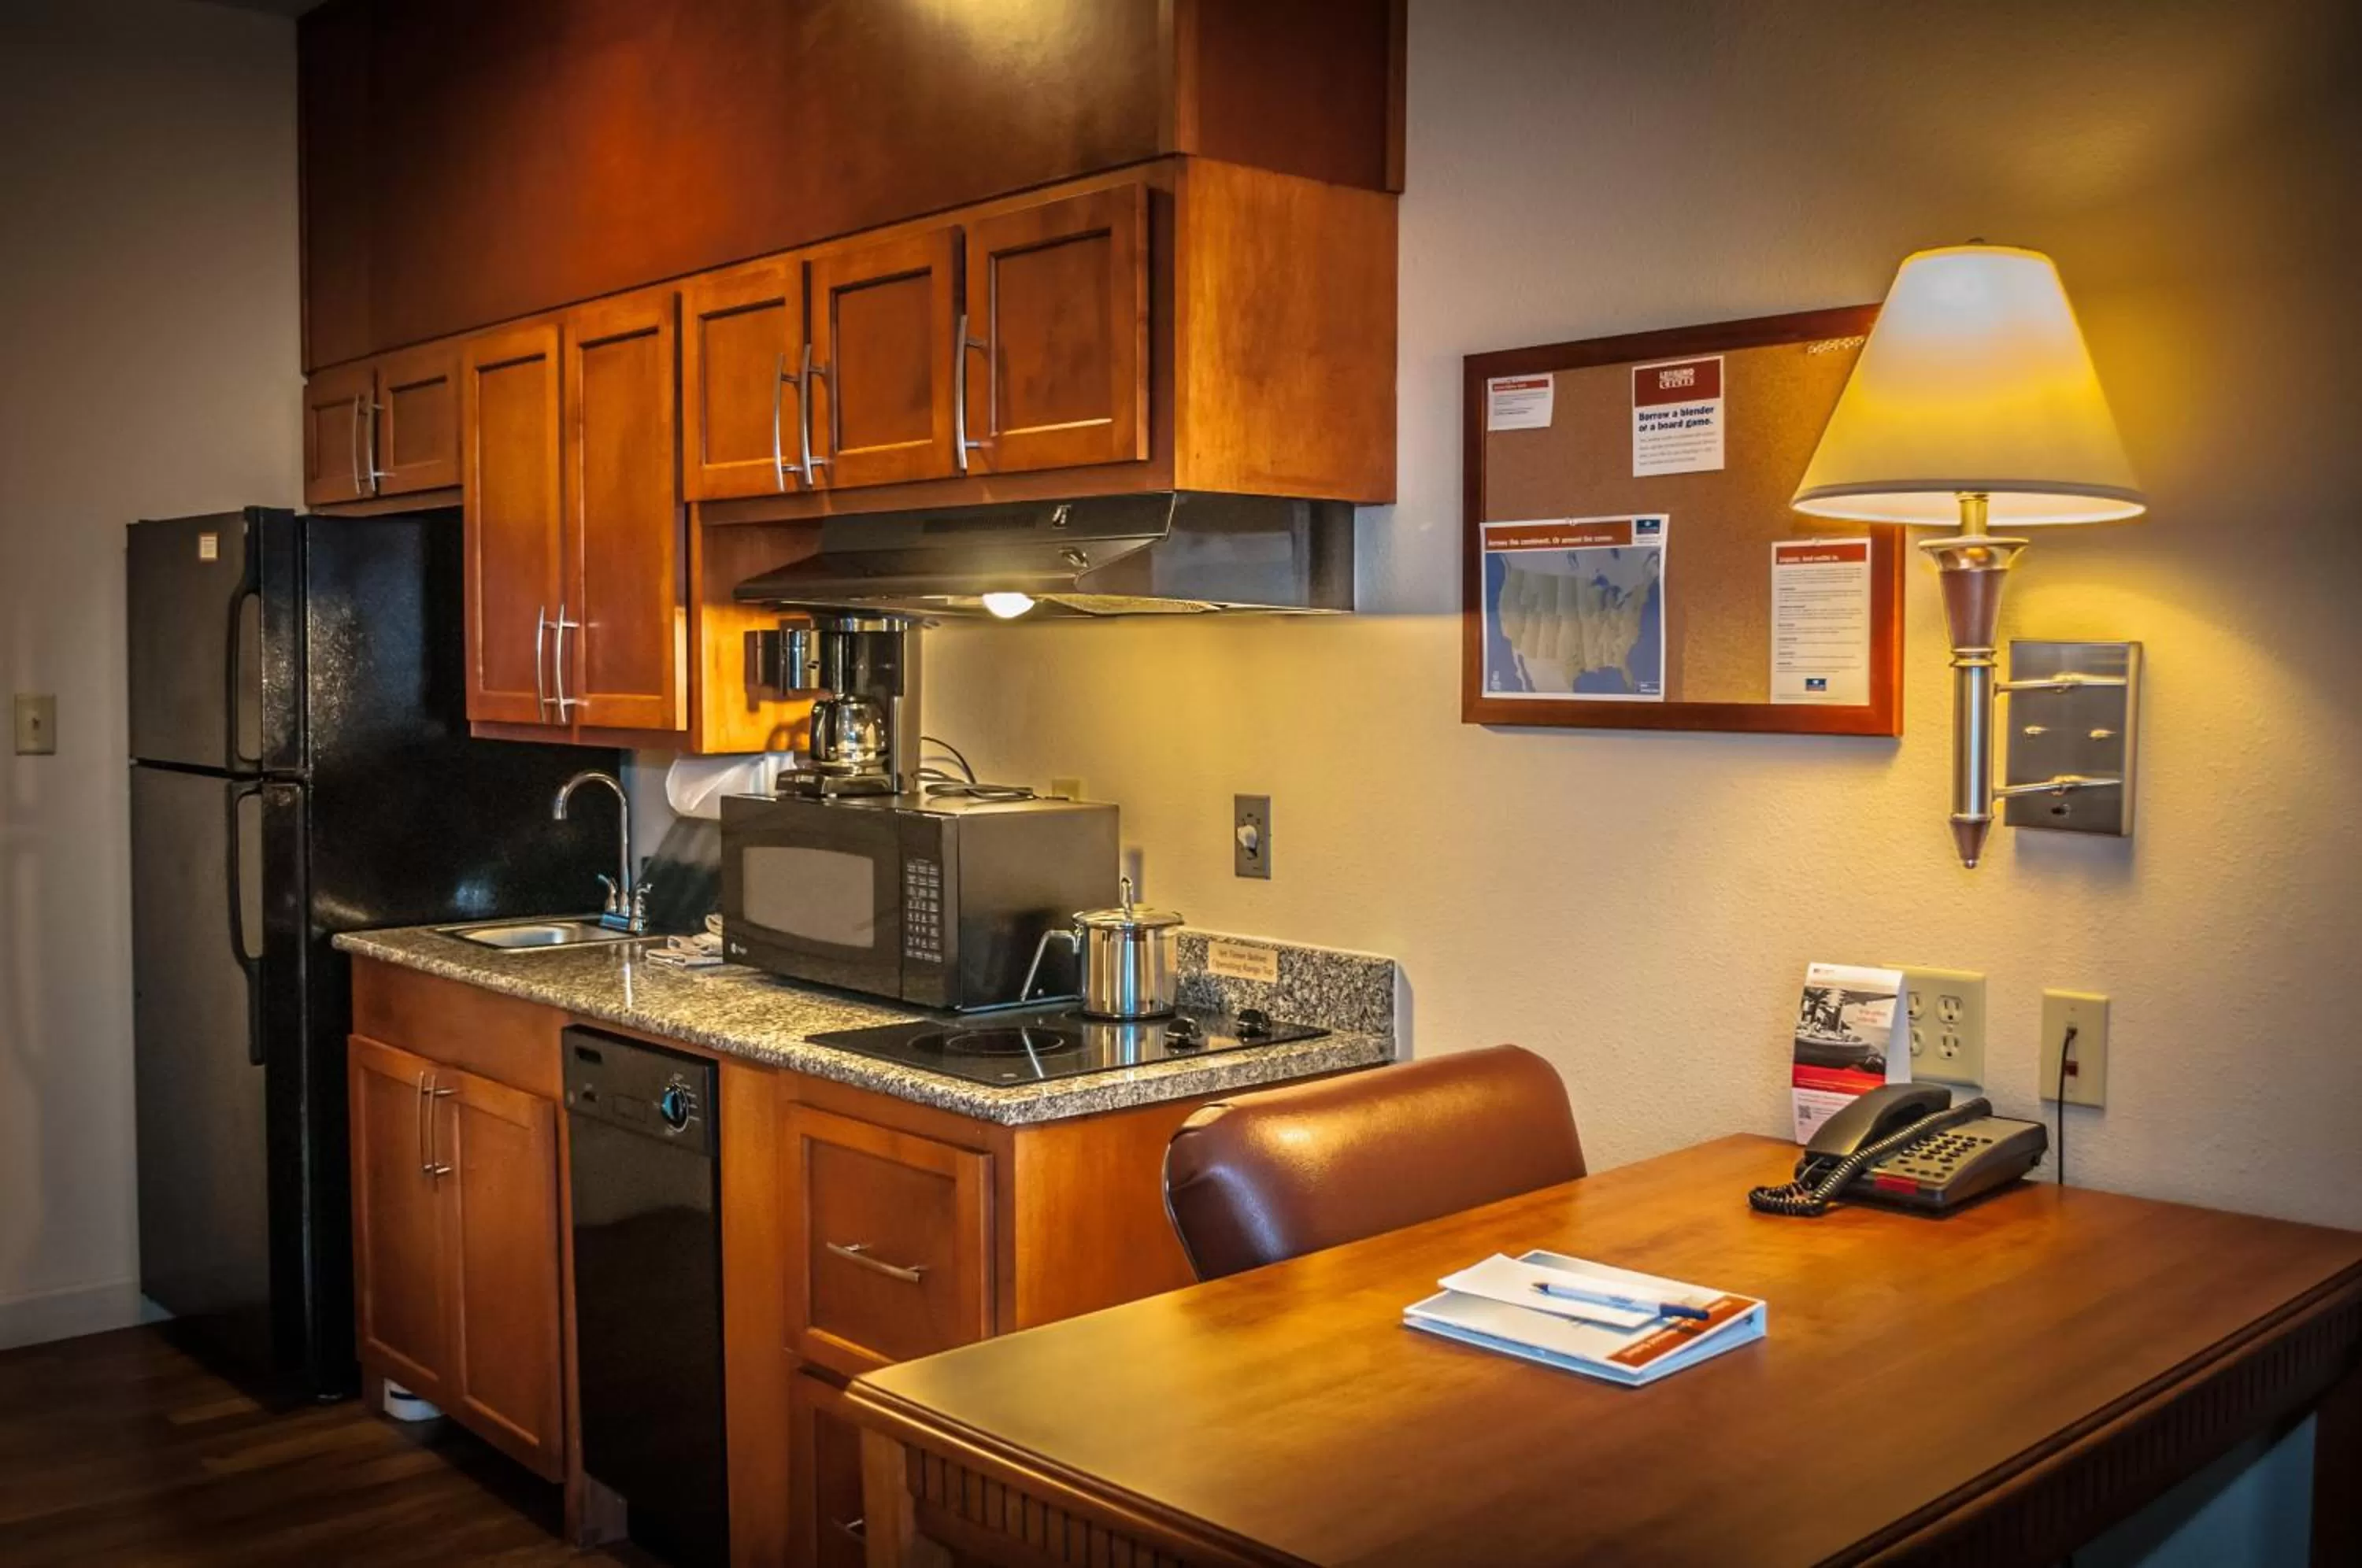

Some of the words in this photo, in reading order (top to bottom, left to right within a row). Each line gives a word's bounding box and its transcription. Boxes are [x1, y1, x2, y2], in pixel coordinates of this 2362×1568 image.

[1638, 411, 1669, 421] Borrow
[1680, 406, 1714, 416] blender
[1638, 424, 1648, 433] or
[1649, 423, 1656, 431] a
[1658, 420, 1683, 430] board
[1686, 418, 1713, 428] game.
